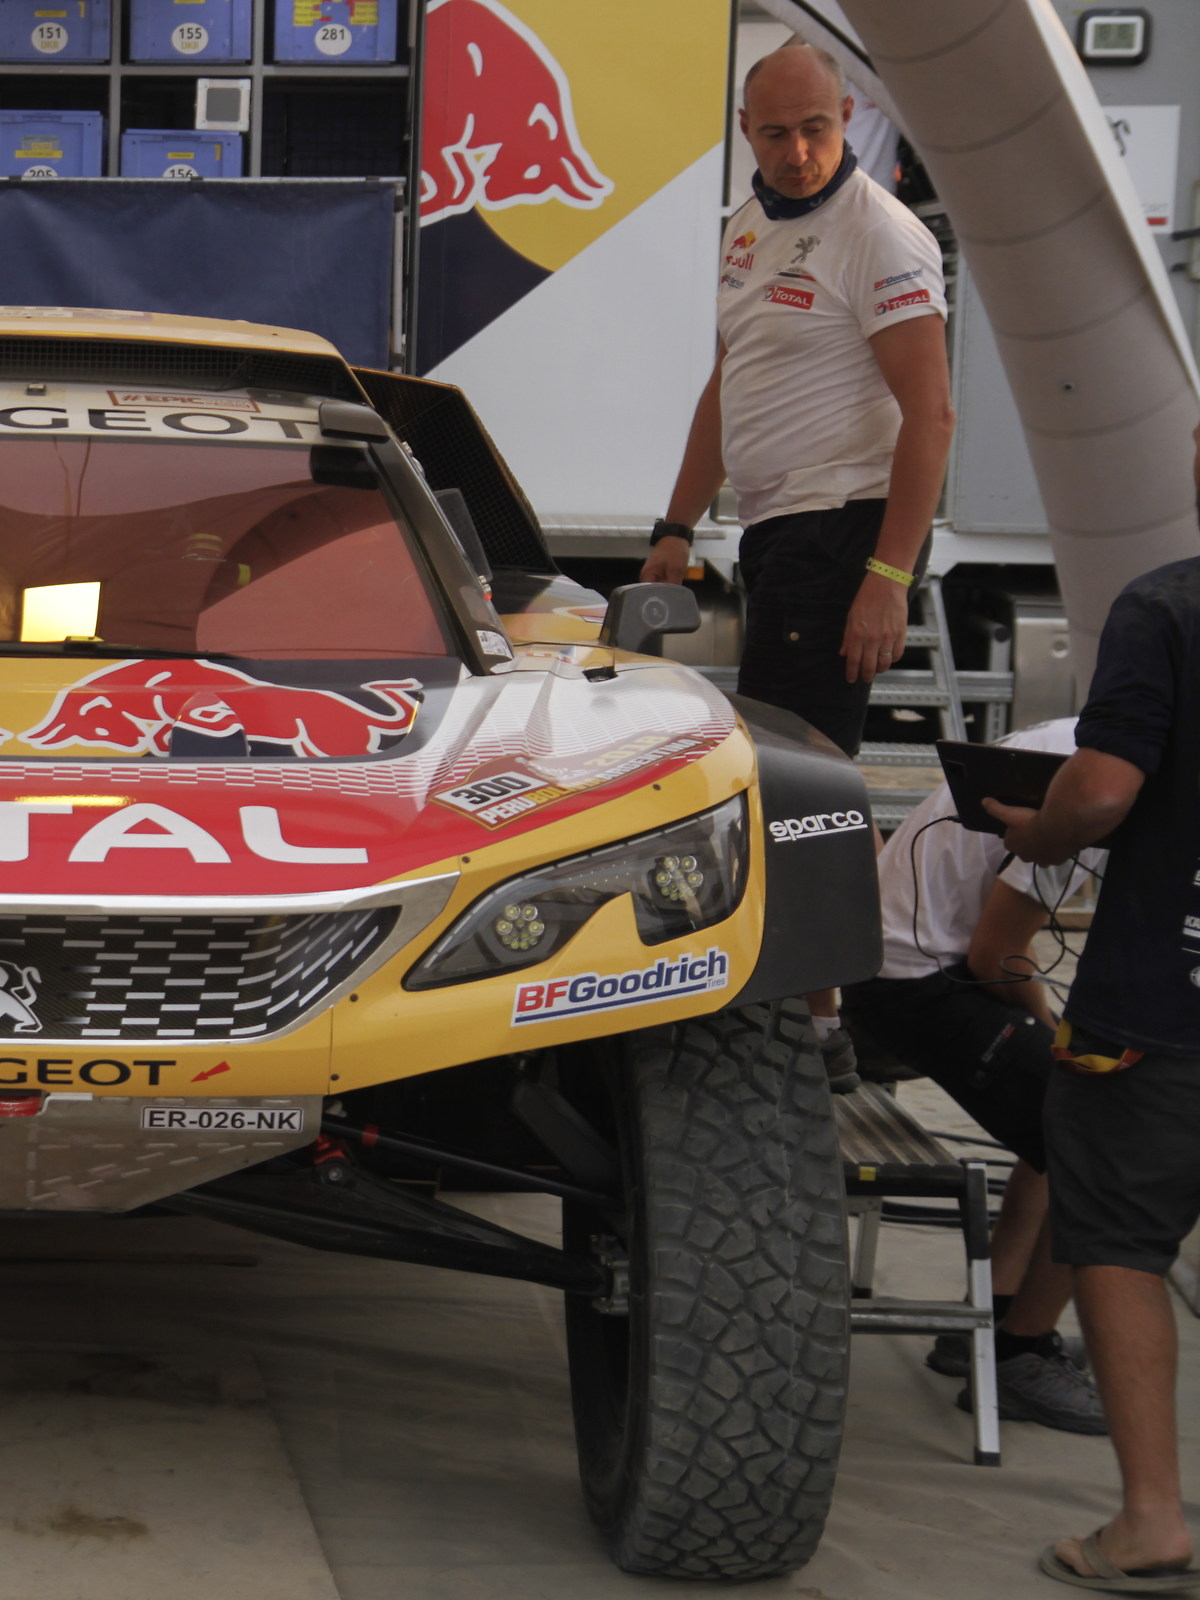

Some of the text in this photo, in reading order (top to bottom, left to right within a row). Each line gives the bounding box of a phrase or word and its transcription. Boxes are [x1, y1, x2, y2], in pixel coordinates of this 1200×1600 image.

[39, 27, 62, 39] 151
[179, 27, 203, 39] 155
[321, 28, 345, 40] 281
[775, 290, 811, 306] TOTAL
[892, 294, 929, 309] TOTAL
[122, 394, 204, 405] #EPIC
[584, 734, 673, 768] 2018
[450, 775, 533, 805] 300
[769, 809, 866, 842] sparco
[516, 949, 728, 1013] BFGoodrich
[705, 976, 727, 989] Tires
[147, 1109, 300, 1132] ER-026-NK
